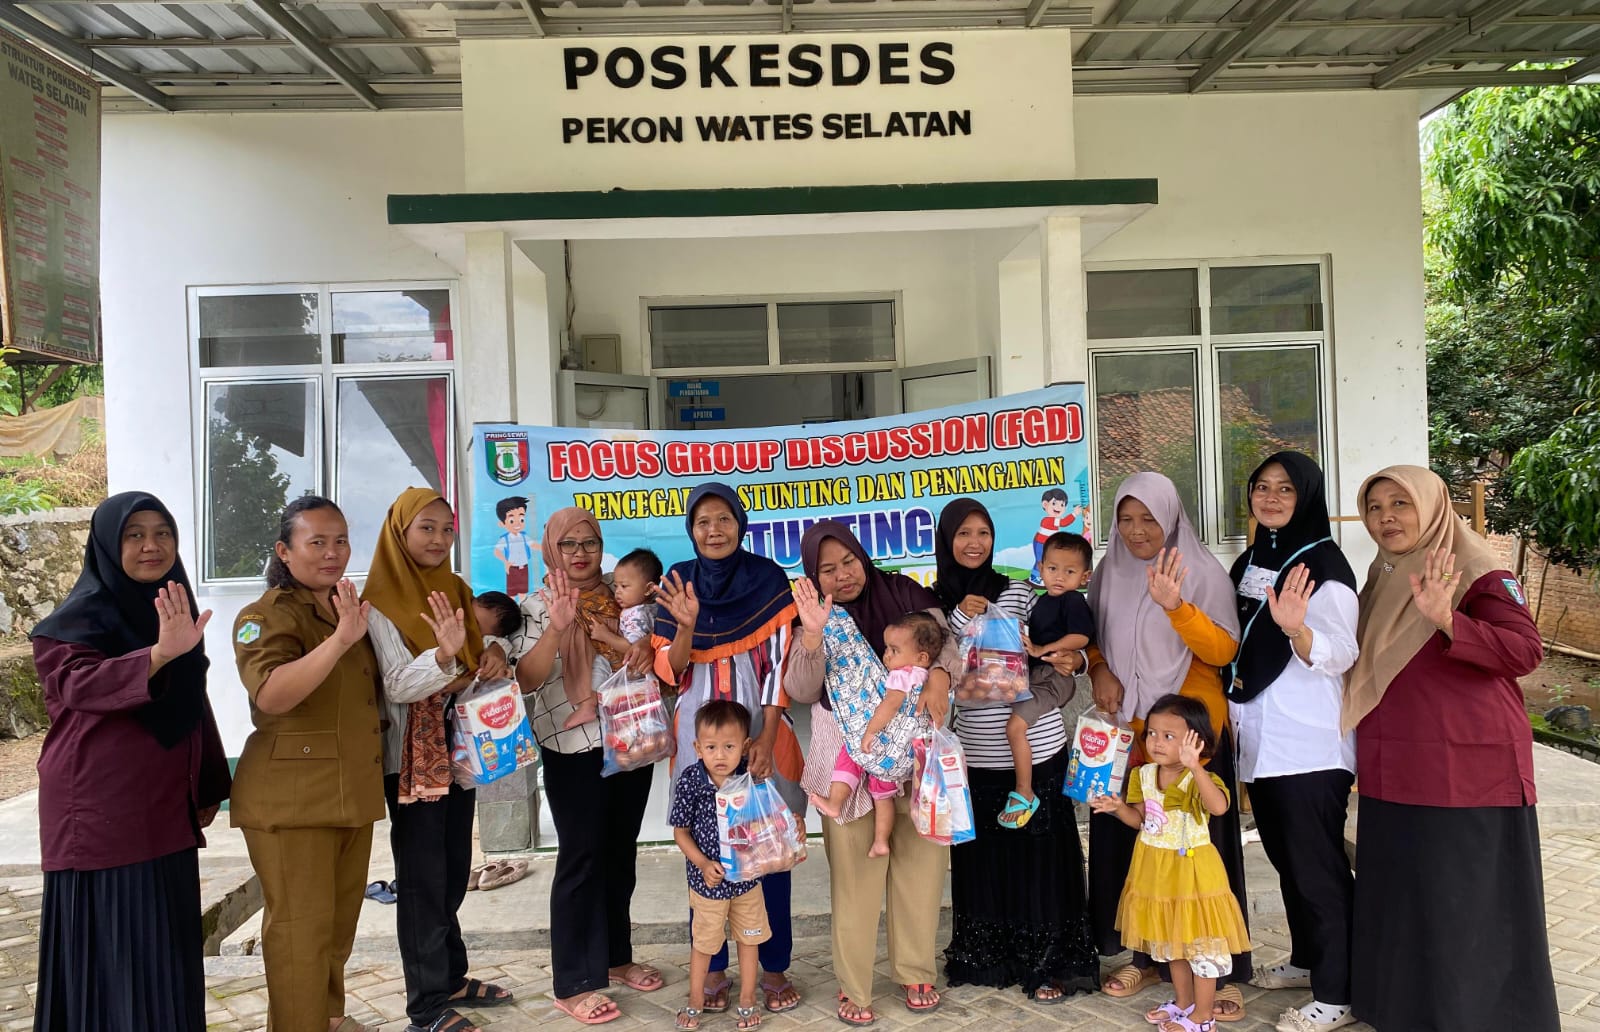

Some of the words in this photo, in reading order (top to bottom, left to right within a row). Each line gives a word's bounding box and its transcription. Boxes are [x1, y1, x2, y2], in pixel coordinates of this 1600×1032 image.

[1, 42, 45, 74] STRUKTUR
[46, 66, 91, 101] POSKESDES
[8, 61, 44, 93] WATES
[46, 82, 87, 117] SELATAN
[563, 42, 956, 90] POSKESDES
[562, 116, 683, 144] PEKON
[695, 113, 814, 142] WATES
[822, 109, 972, 140] SELATAN
[547, 440, 661, 482] FOCUS
[663, 437, 783, 477] GROUP
[784, 412, 990, 470] DISCUSSION
[992, 403, 1084, 450] (FGD)
[573, 486, 689, 520] PENCEGA
[737, 476, 851, 512] STUNTING
[856, 472, 905, 503] DAN
[910, 456, 1065, 498] PENANGANAN
